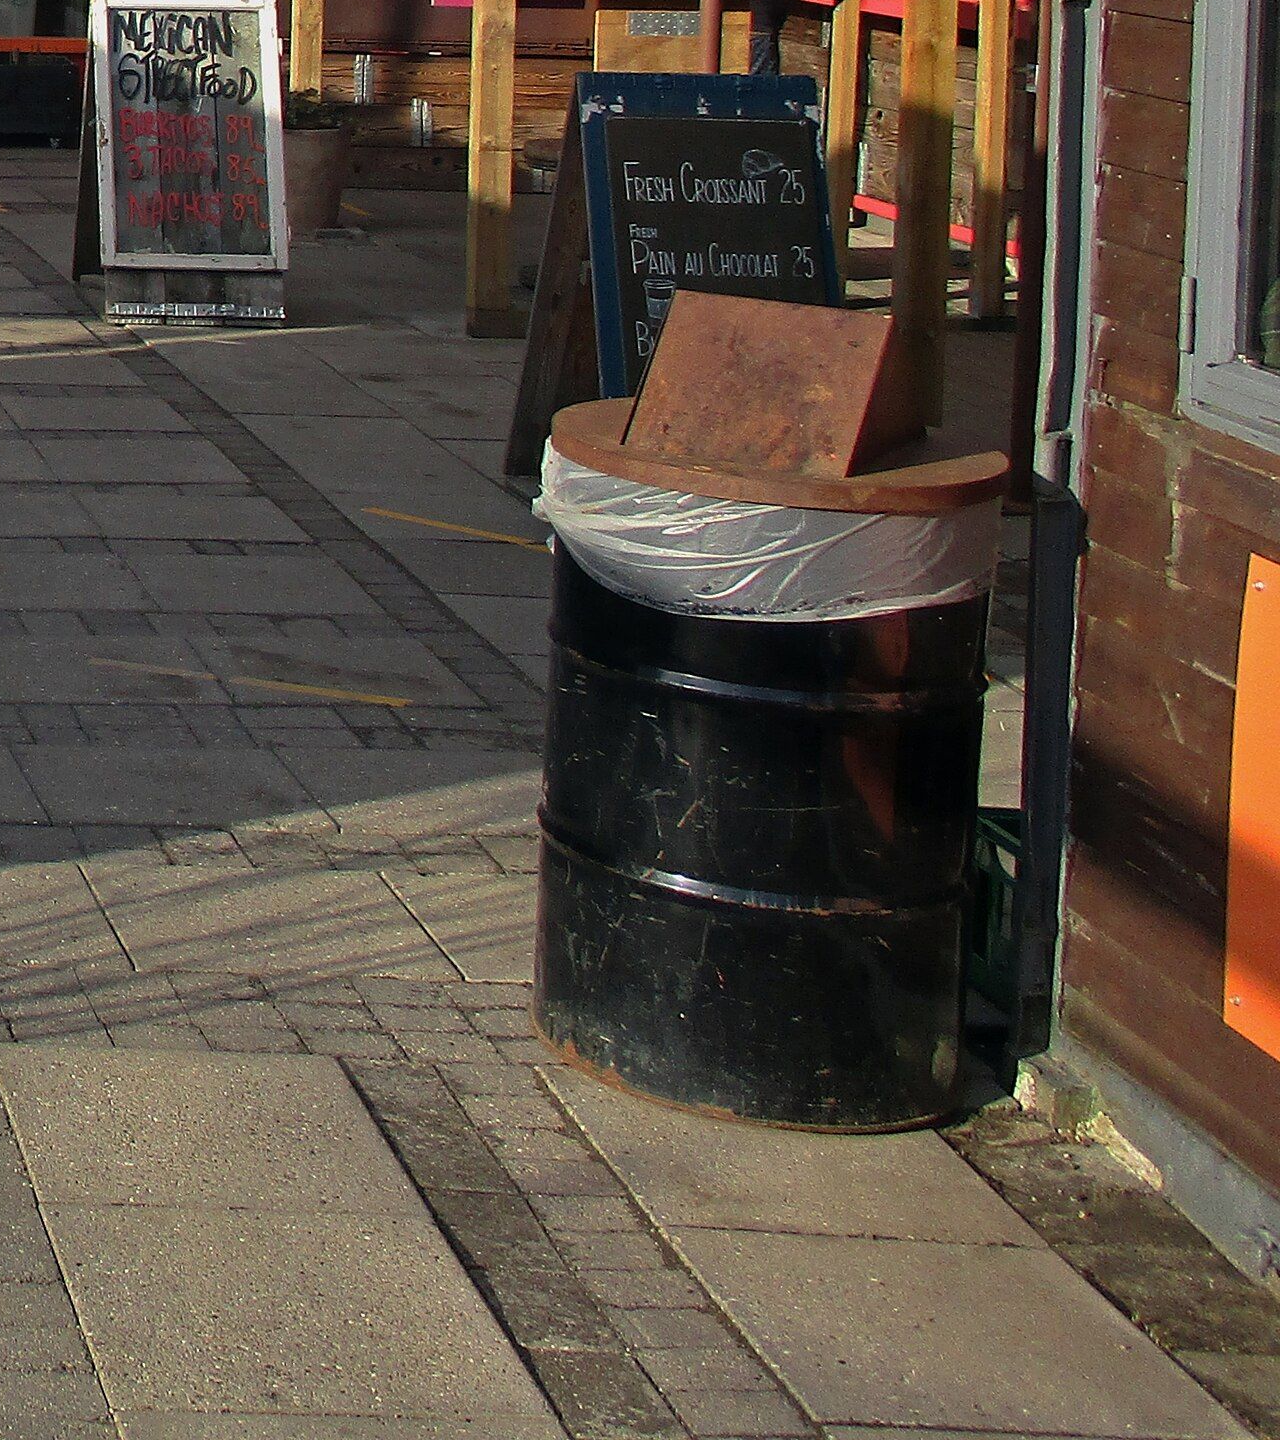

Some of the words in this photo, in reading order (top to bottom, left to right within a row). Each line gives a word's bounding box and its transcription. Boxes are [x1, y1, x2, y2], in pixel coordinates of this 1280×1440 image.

[123, 143, 144, 180] 3
[623, 160, 674, 202] FRESH
[680, 160, 768, 205] CROISSANT
[778, 168, 806, 205] 25
[127, 190, 225, 229] NACHOS
[627, 222, 658, 239] FRESH
[630, 238, 677, 276] PAIN
[684, 251, 704, 276] AU
[708, 242, 779, 278] CHOCOLAT
[789, 245, 816, 279] 25
